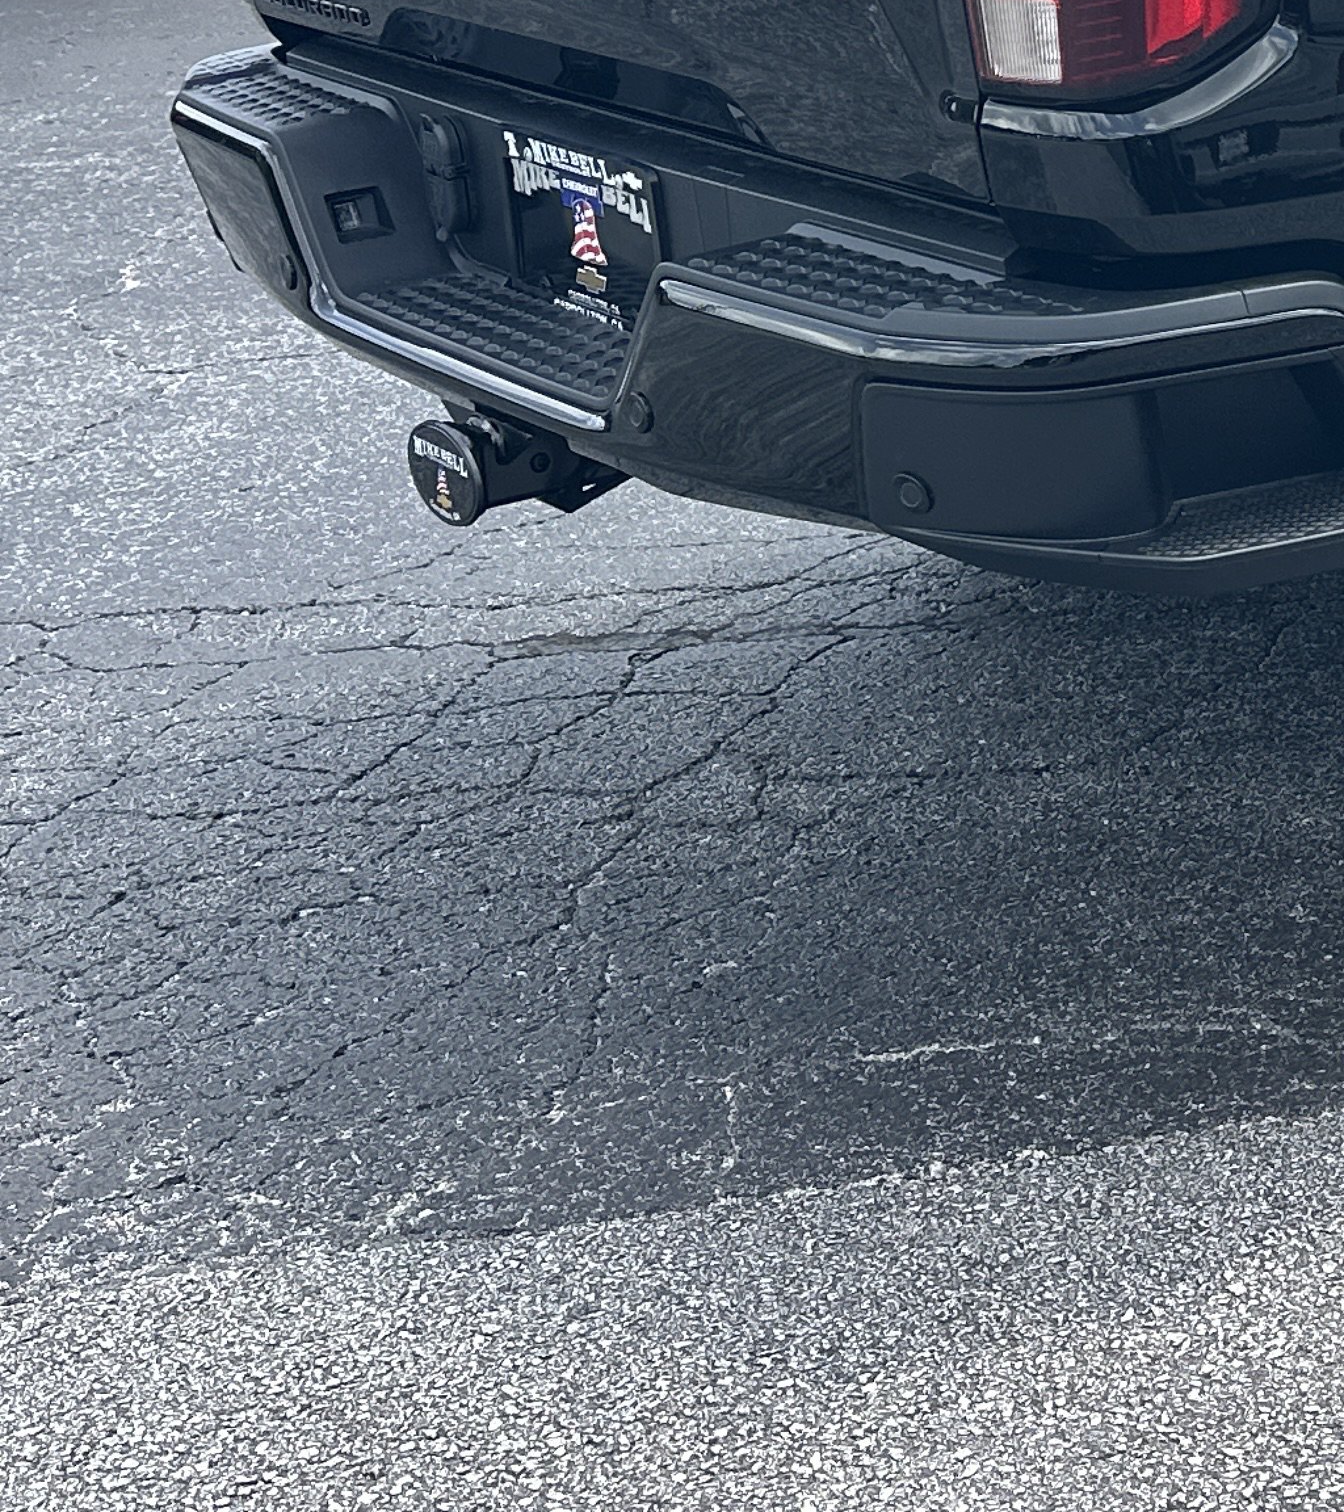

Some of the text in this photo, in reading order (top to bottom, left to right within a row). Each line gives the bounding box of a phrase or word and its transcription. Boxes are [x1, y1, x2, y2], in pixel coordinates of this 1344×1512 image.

[511, 157, 562, 197] MIKE
[527, 137, 569, 165] MIKE
[568, 149, 616, 186] BELL
